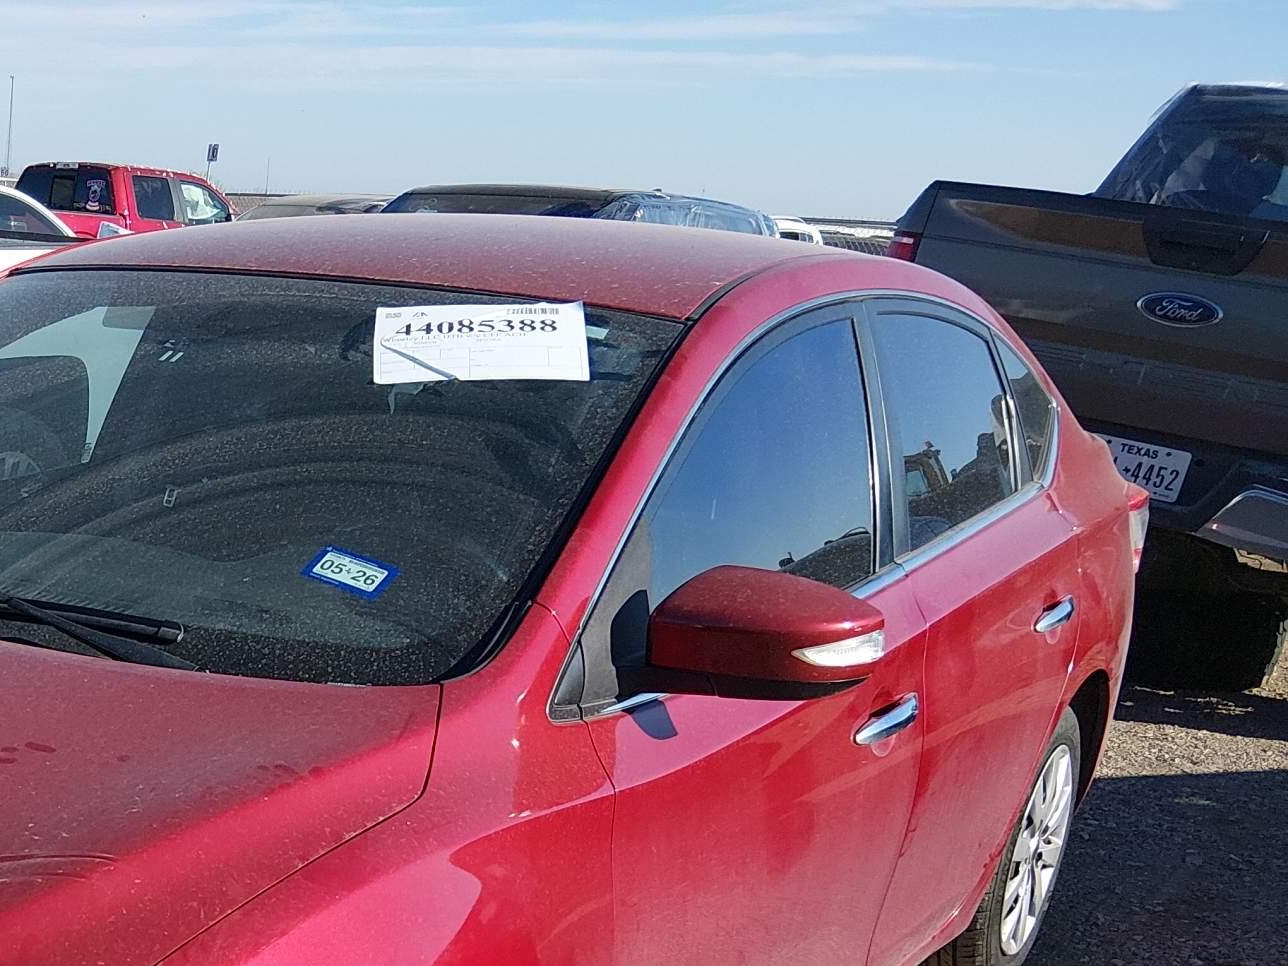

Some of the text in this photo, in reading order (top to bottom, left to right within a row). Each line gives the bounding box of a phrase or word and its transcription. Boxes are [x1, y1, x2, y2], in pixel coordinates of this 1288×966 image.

[1155, 298, 1204, 321] Ford
[395, 318, 558, 337] 44085388
[1119, 442, 1160, 460] TEXAS
